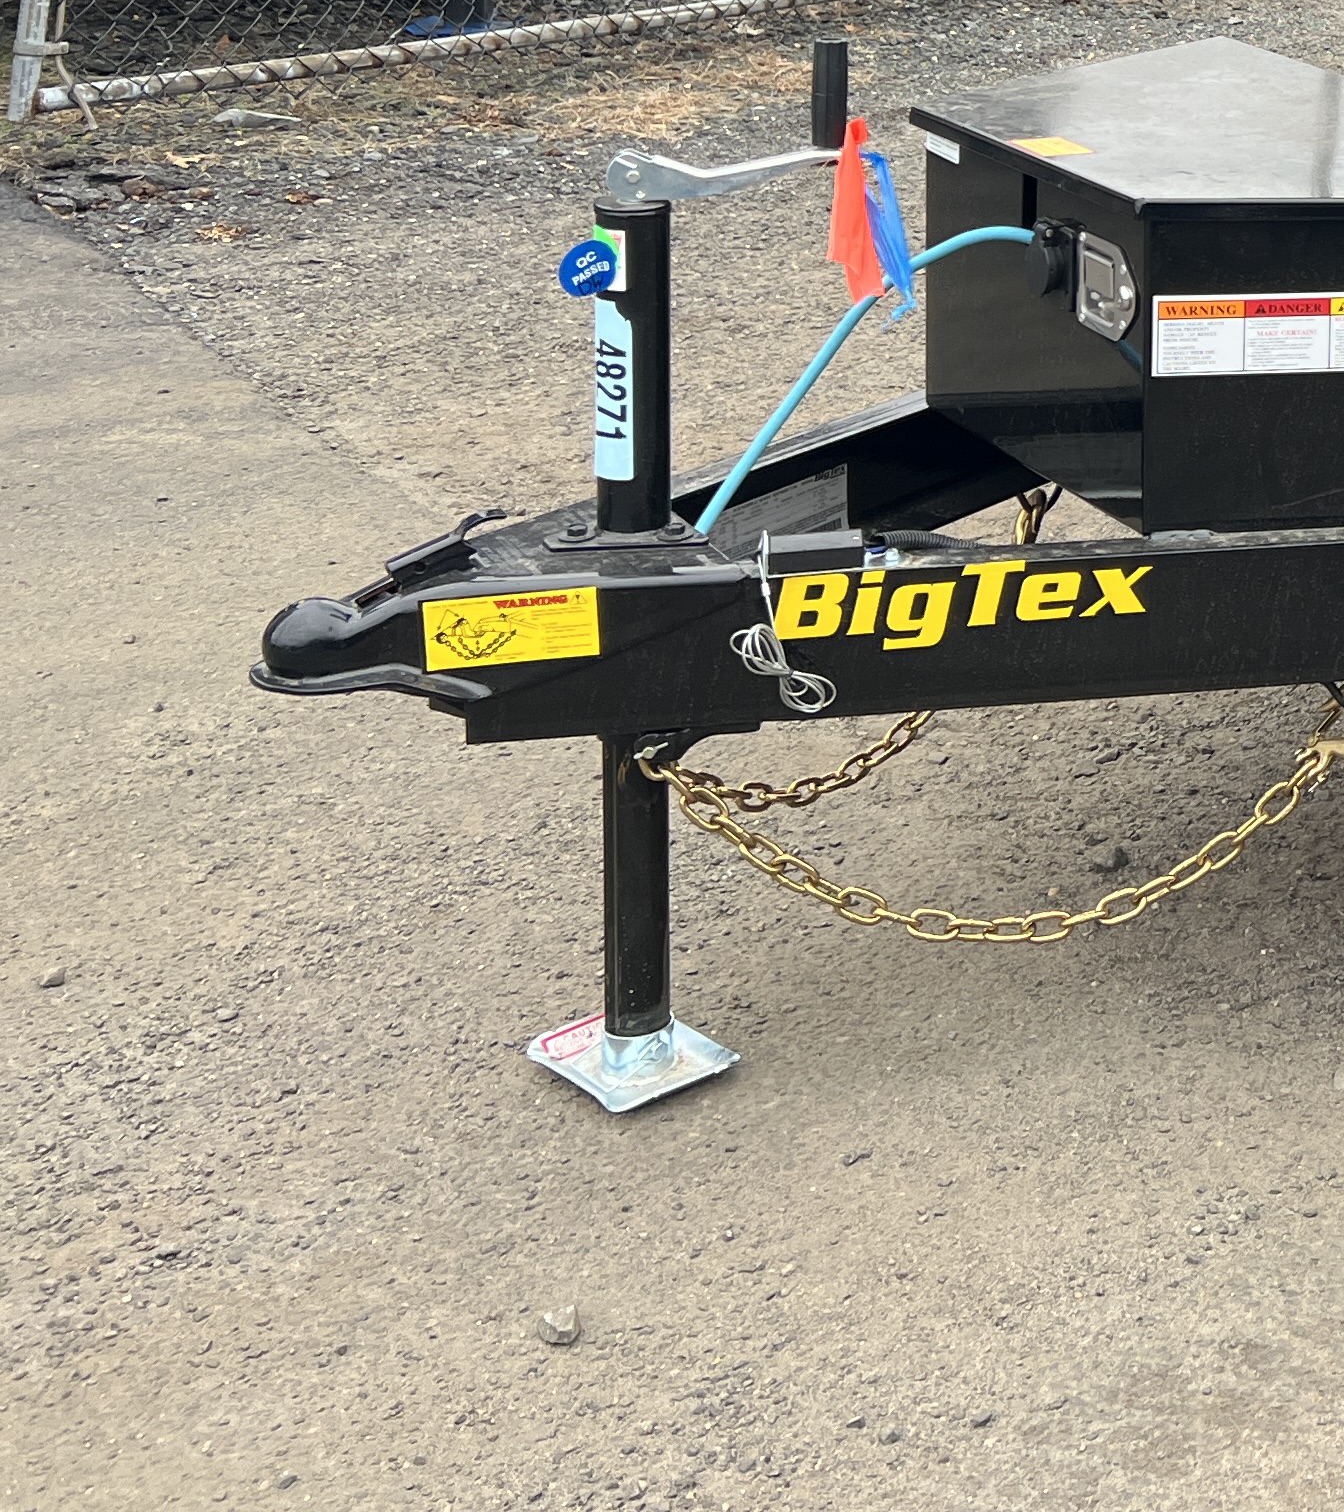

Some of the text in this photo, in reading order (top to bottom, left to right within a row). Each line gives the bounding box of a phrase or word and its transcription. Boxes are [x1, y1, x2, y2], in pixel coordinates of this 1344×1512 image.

[571, 260, 610, 286] PASSED
[1166, 304, 1236, 317] WARNING
[1268, 303, 1322, 314] DANGER
[596, 338, 627, 439] 48271
[493, 594, 569, 610] WARNING
[774, 559, 1153, 651] BigTex
